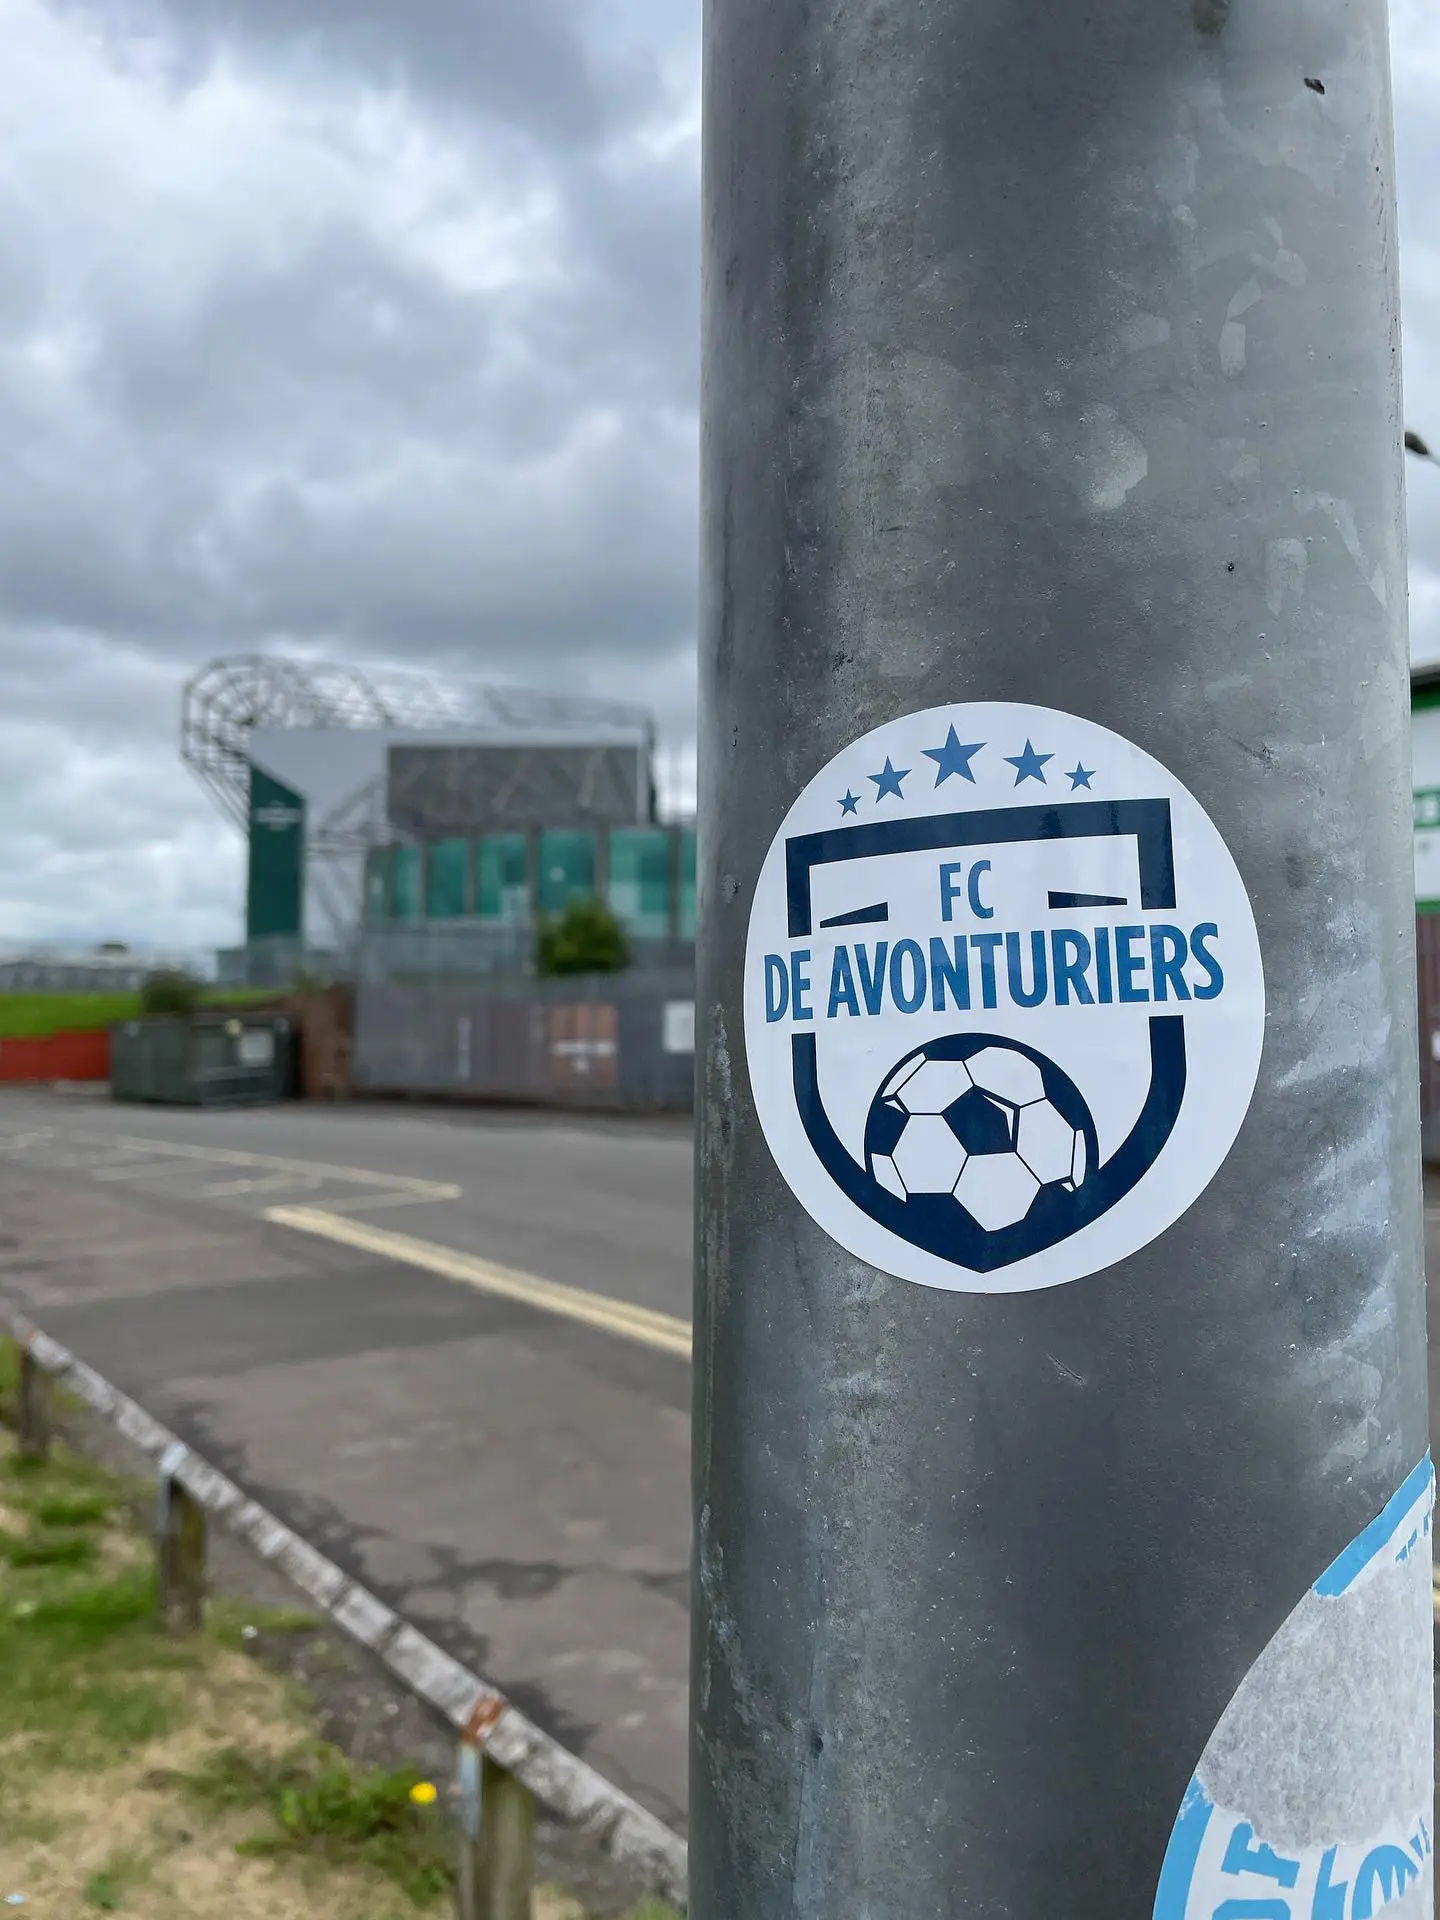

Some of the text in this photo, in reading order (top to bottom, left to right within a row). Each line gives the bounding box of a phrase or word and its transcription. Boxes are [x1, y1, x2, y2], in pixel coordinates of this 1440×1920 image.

[939, 859, 994, 922] FC
[763, 921, 1225, 1024] DE AVONTURIERS
